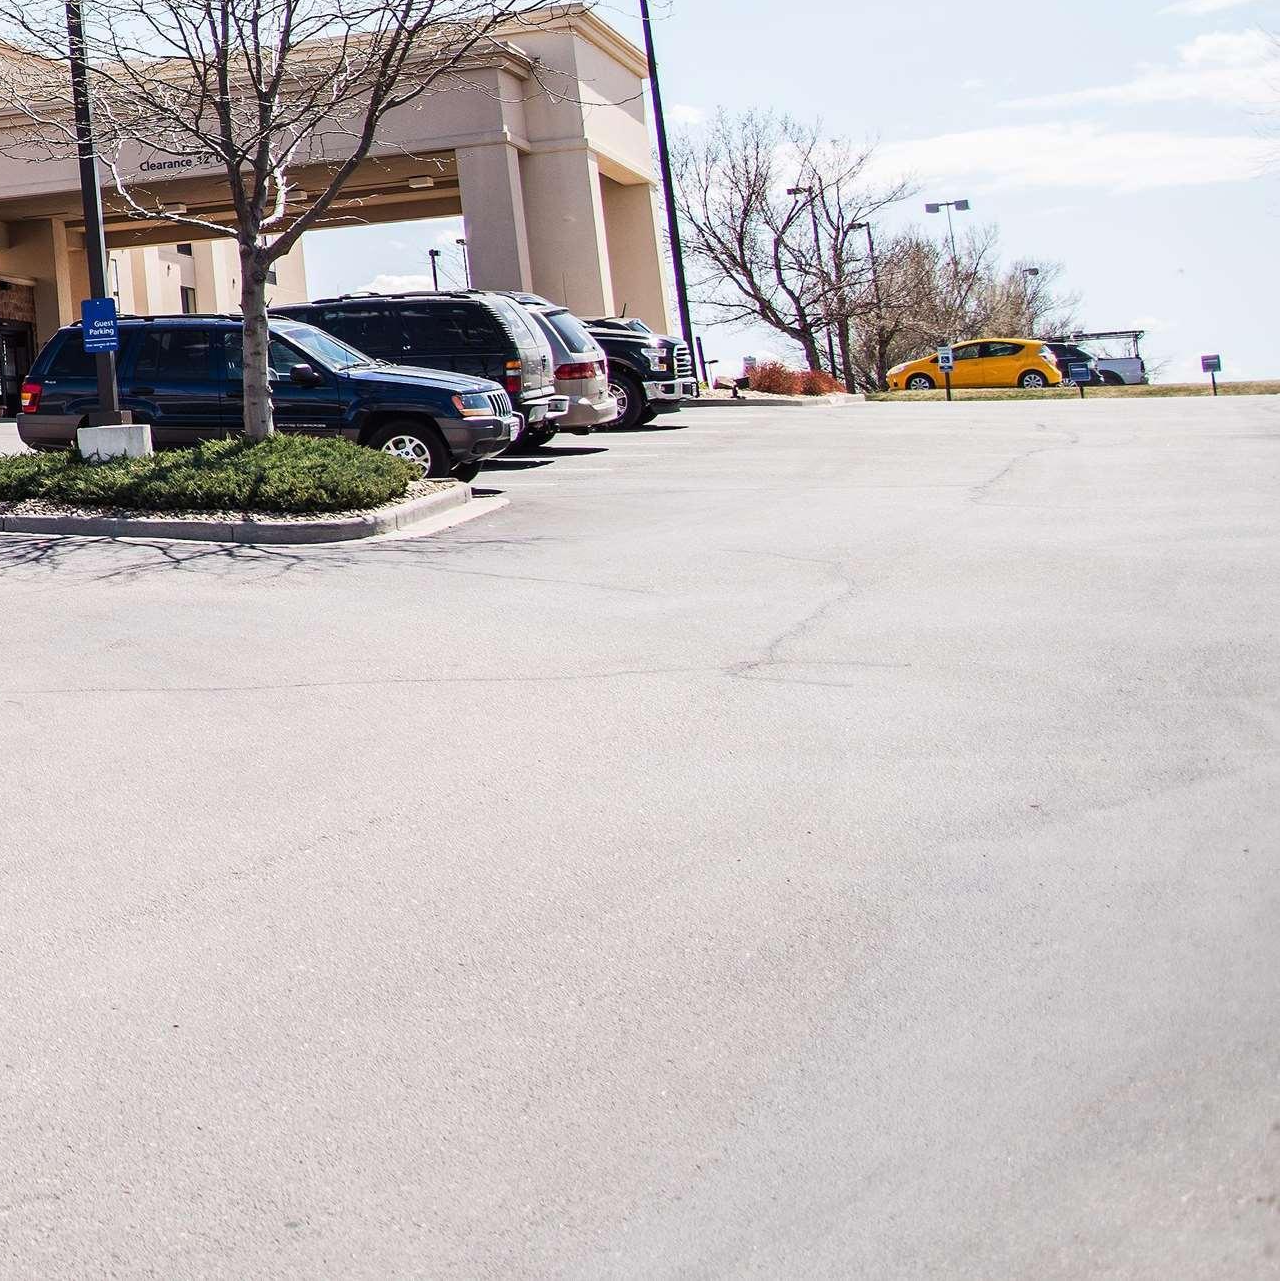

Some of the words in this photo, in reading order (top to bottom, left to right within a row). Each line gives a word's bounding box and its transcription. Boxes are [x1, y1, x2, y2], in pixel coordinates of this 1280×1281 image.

[139, 158, 193, 172] Clearance
[94, 320, 114, 328] Guest
[89, 328, 115, 336] Parking
